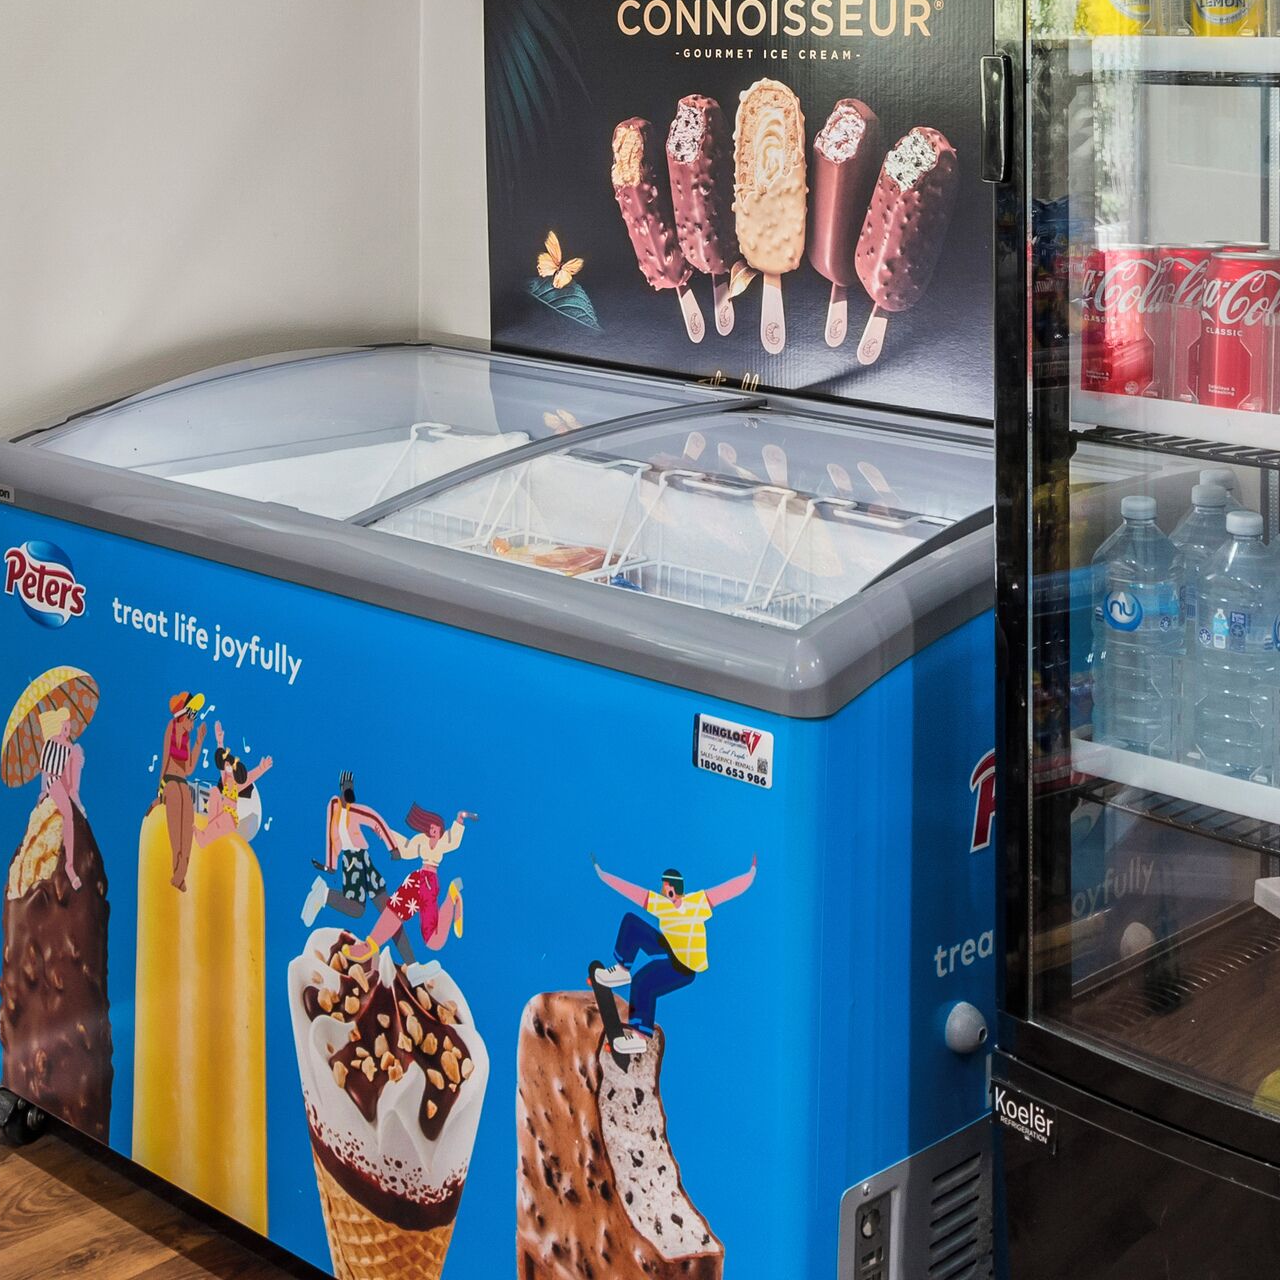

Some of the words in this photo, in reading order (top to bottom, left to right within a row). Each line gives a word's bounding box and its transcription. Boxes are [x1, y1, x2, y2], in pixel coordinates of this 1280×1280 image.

[762, 47, 789, 61] ICE
[1205, 326, 1244, 338] CLASSIC
[4, 548, 86, 616] Peters
[1110, 598, 1136, 618] nu
[112, 596, 169, 639] treat
[173, 611, 209, 651] life
[213, 624, 303, 686] joyfully
[700, 758, 723, 773] 1800
[725, 766, 745, 780] 653
[747, 772, 767, 787] 986
[934, 928, 995, 978] trea
[995, 1085, 1054, 1137] Koelër
[1000, 1114, 1048, 1145] REFRIGERATION
